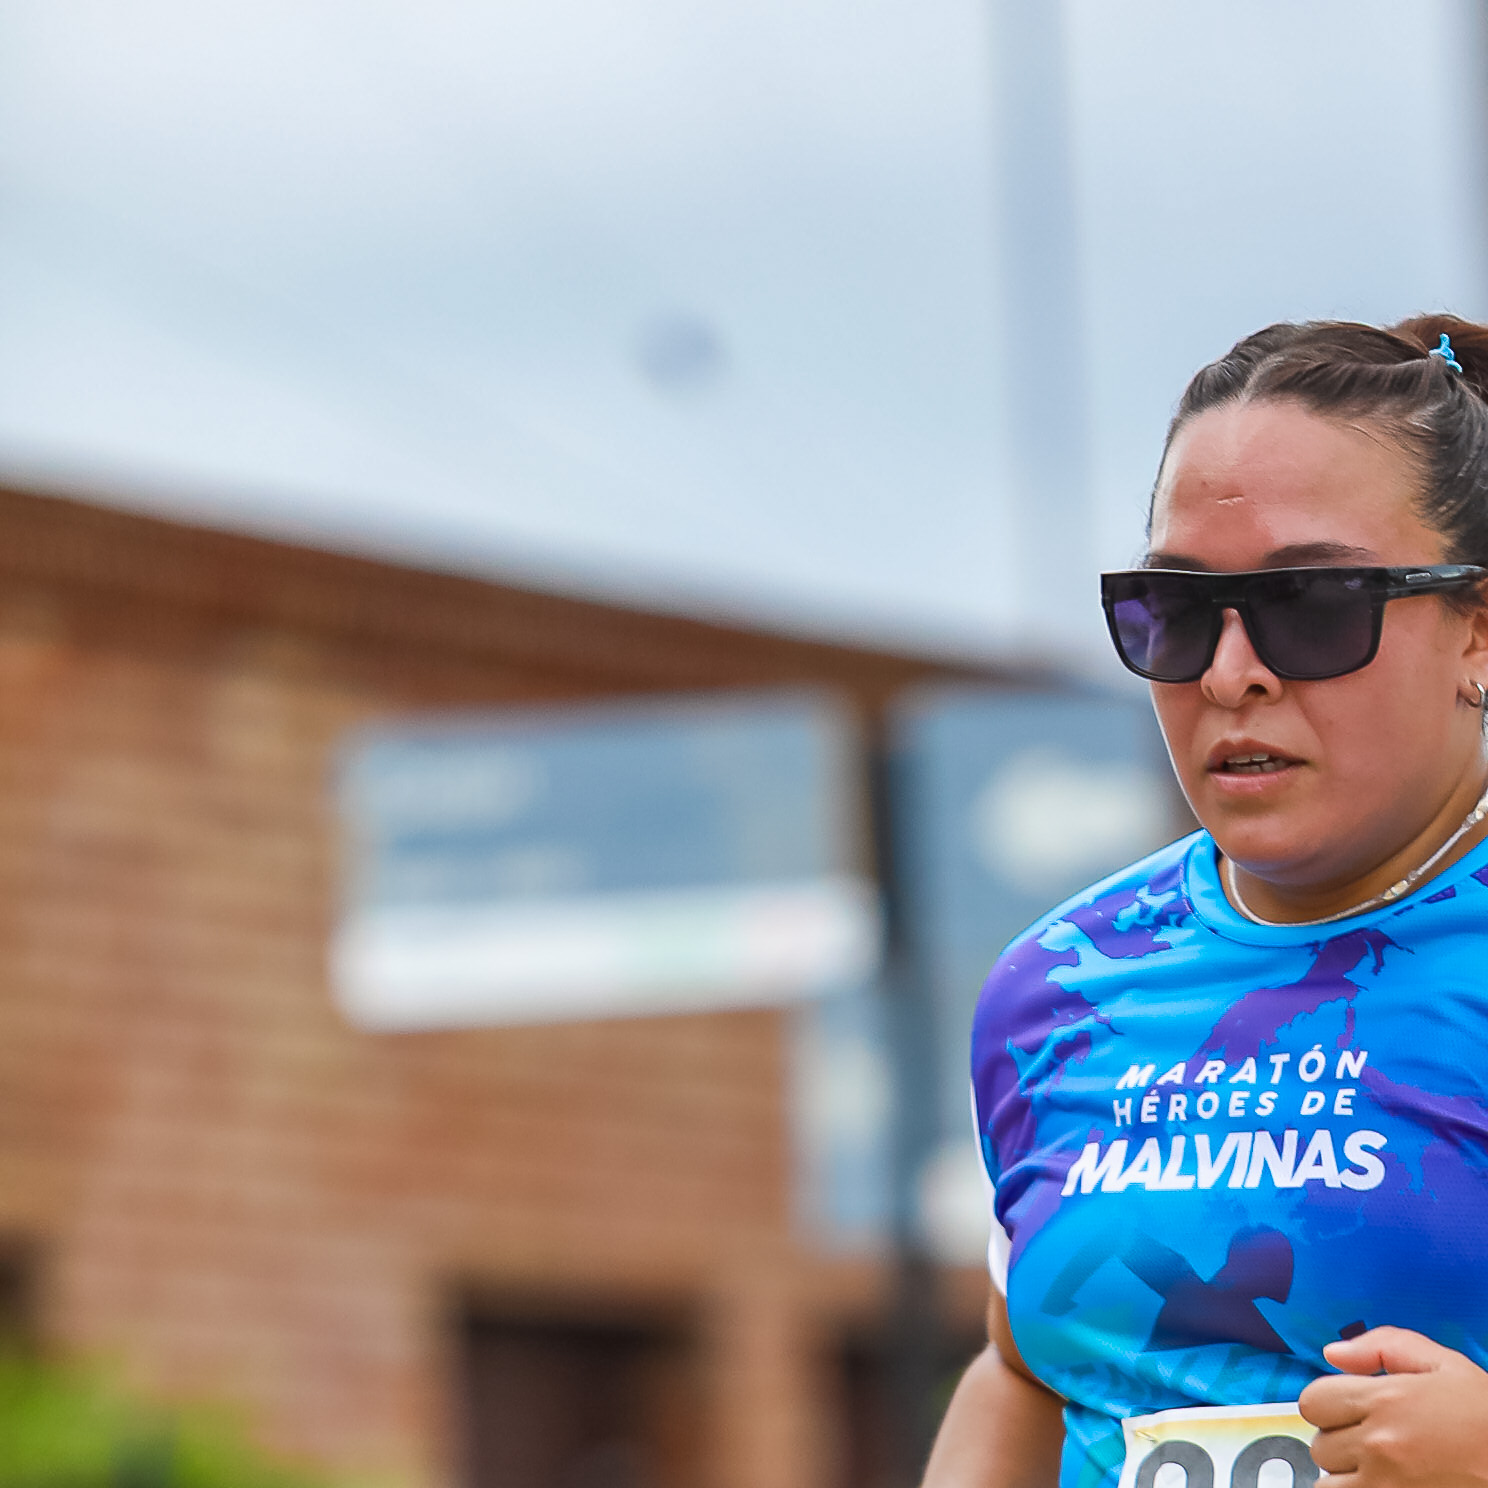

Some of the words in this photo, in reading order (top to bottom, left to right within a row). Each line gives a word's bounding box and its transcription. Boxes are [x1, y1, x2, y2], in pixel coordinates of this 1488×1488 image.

[1116, 1044, 1369, 1090] MARATÓN
[1113, 1090, 1279, 1127] HÉROES
[1300, 1088, 1357, 1117] DE
[1061, 1128, 1388, 1197] MALVINAS
